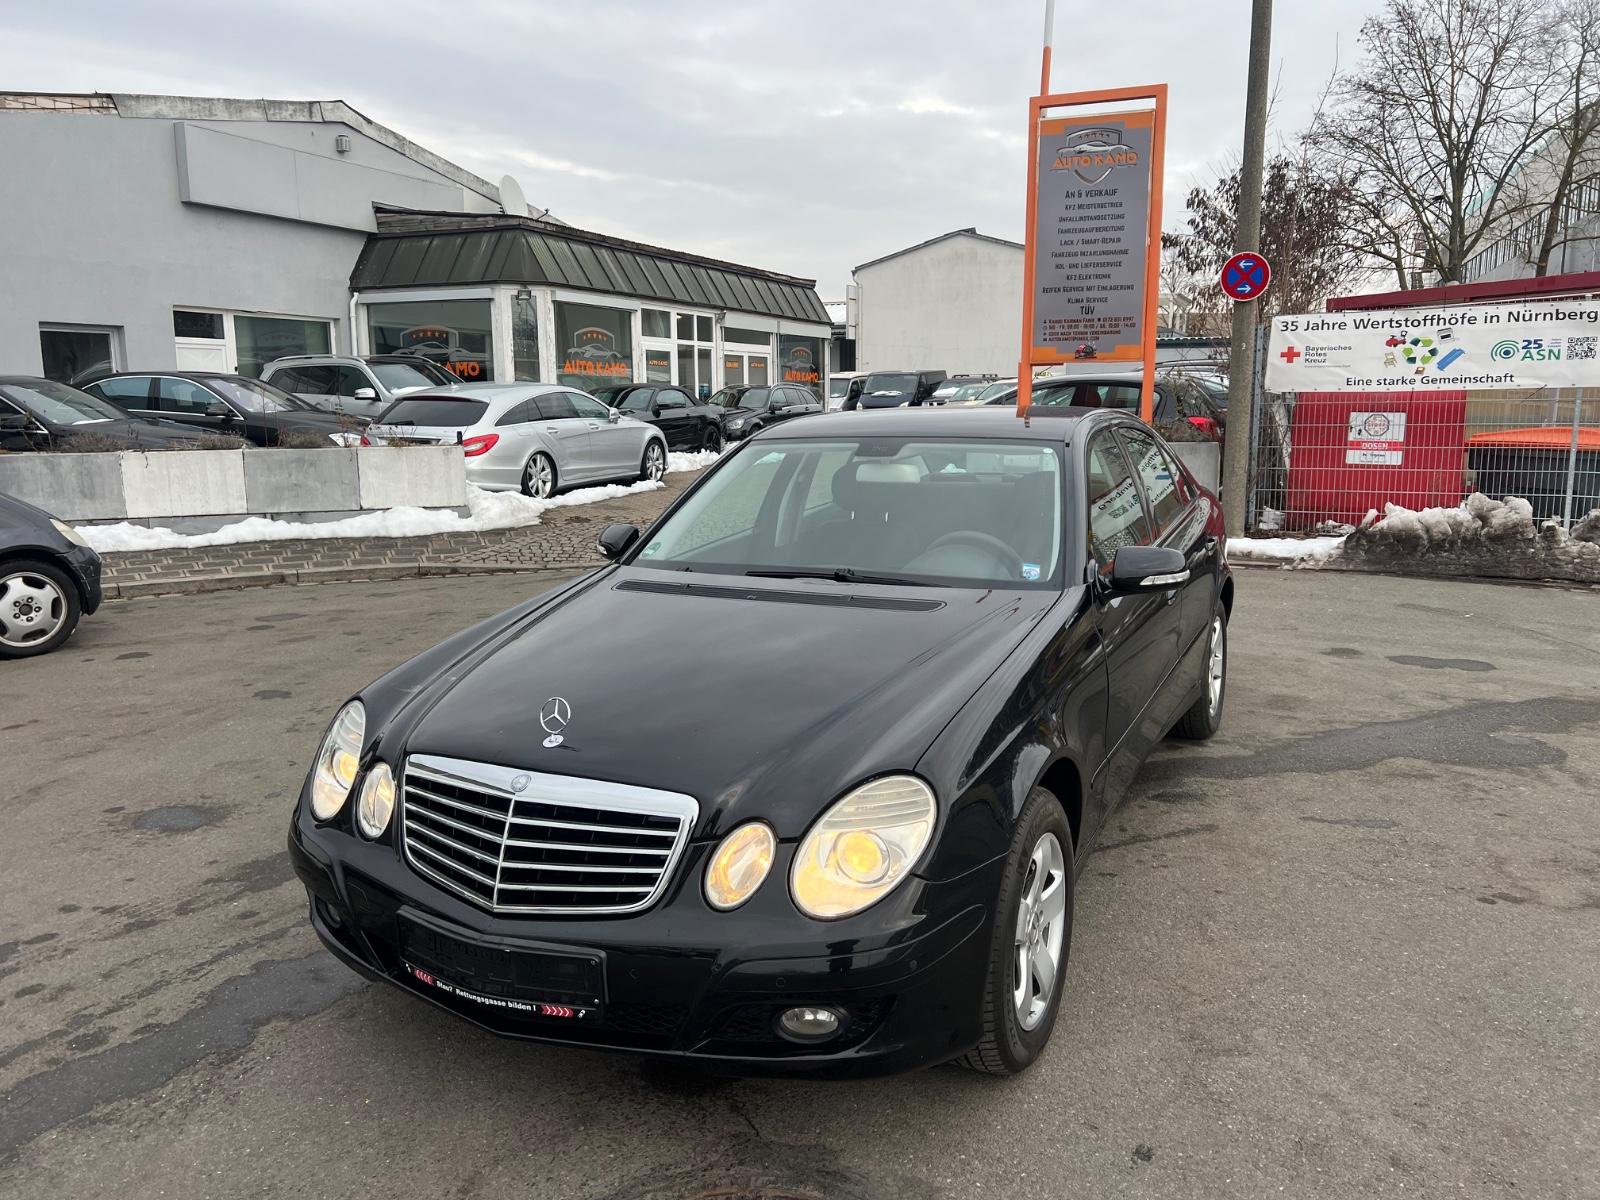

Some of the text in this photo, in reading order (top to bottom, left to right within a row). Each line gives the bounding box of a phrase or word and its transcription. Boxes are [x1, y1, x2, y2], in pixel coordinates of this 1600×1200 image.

[1052, 151, 1138, 169] AUTO KAMO
[1065, 190, 1075, 199] AN
[1085, 188, 1118, 198] VERKAUF
[1080, 304, 1095, 315] TÜV
[1280, 308, 1599, 332] 35 Jahre Wertstoffhöfe in Nürnberg
[1521, 339, 1543, 350] 25
[1521, 349, 1561, 361] ASN
[445, 360, 480, 378] AMO
[563, 359, 628, 377] AUTO KAMO
[1346, 372, 1515, 386] Eine starke Gemeinschaft
[455, 988, 506, 1007] Rettungsgasse
[507, 1000, 532, 1011] bilden
